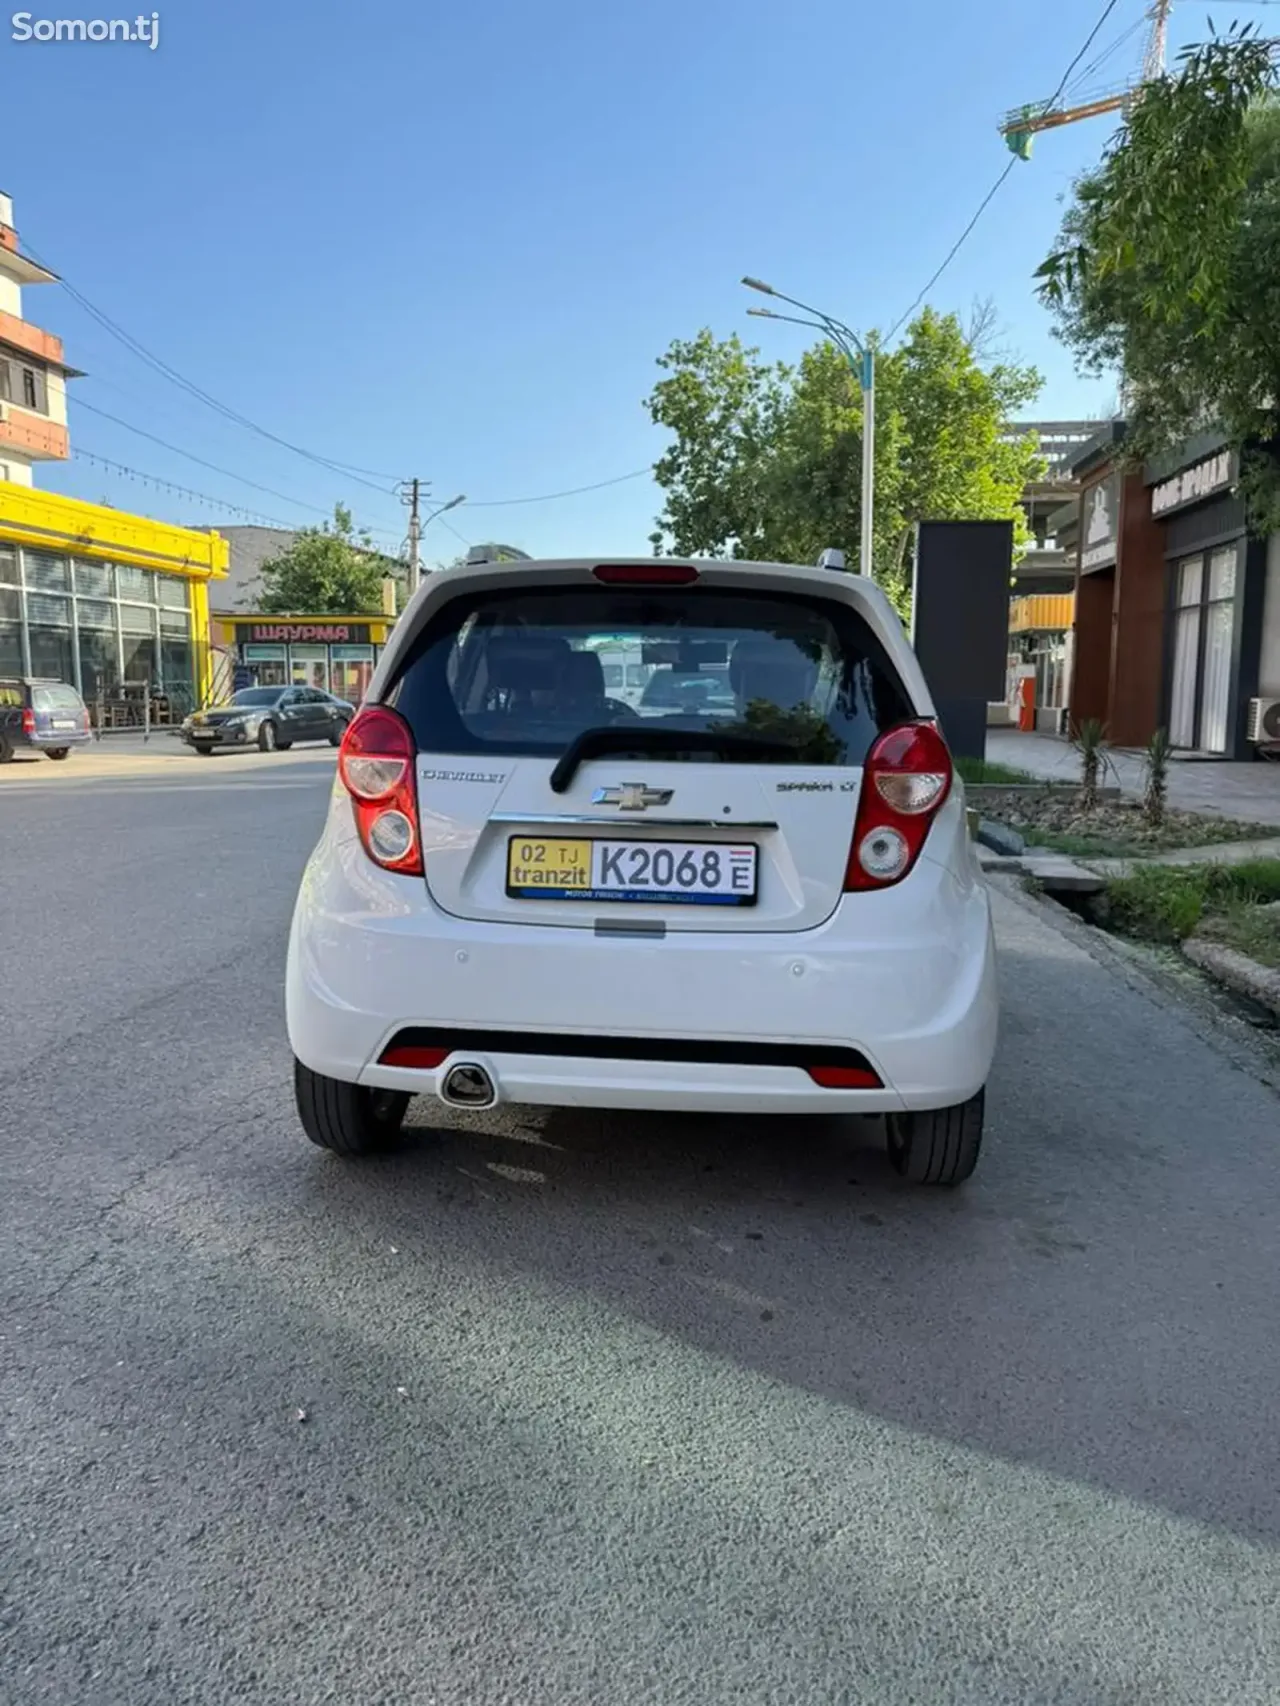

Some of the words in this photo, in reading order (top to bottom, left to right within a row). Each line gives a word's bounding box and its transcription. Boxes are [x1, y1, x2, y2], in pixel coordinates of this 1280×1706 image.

[253, 625, 349, 641] ШАУРМА
[521, 844, 546, 863] 02
[558, 847, 579, 864] TJ
[513, 866, 587, 885] tranzit
[600, 846, 722, 889] K2068
[731, 866, 750, 890] E
